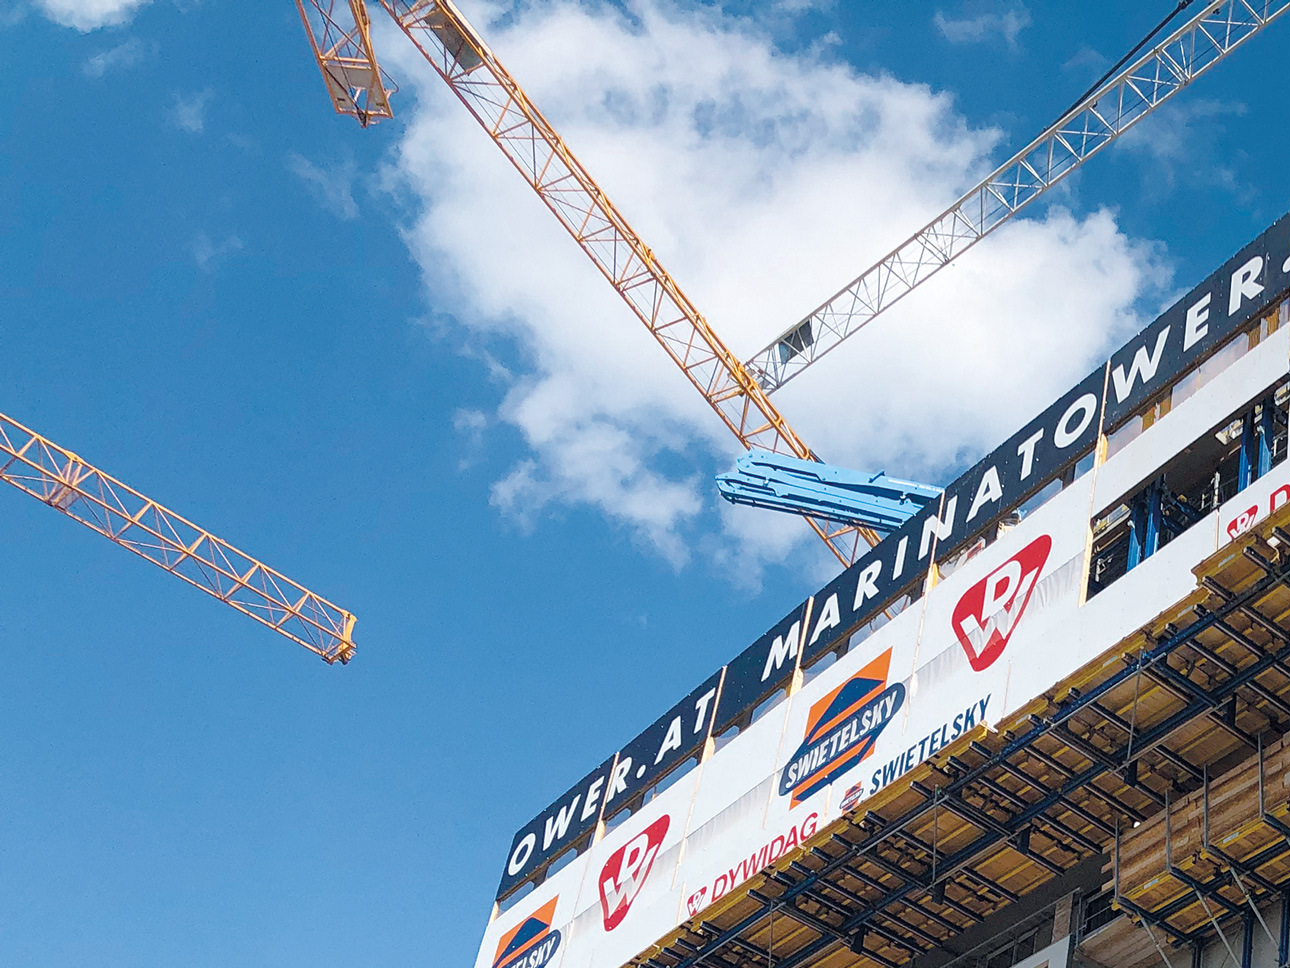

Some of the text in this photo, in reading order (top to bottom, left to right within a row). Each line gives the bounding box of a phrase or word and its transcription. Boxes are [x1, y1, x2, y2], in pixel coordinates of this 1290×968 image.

[508, 687, 716, 876] OWER.AT
[785, 688, 897, 787] SWIETELSKY
[870, 694, 992, 795] SWIETELSKY
[710, 812, 818, 904] DYWIDAG
